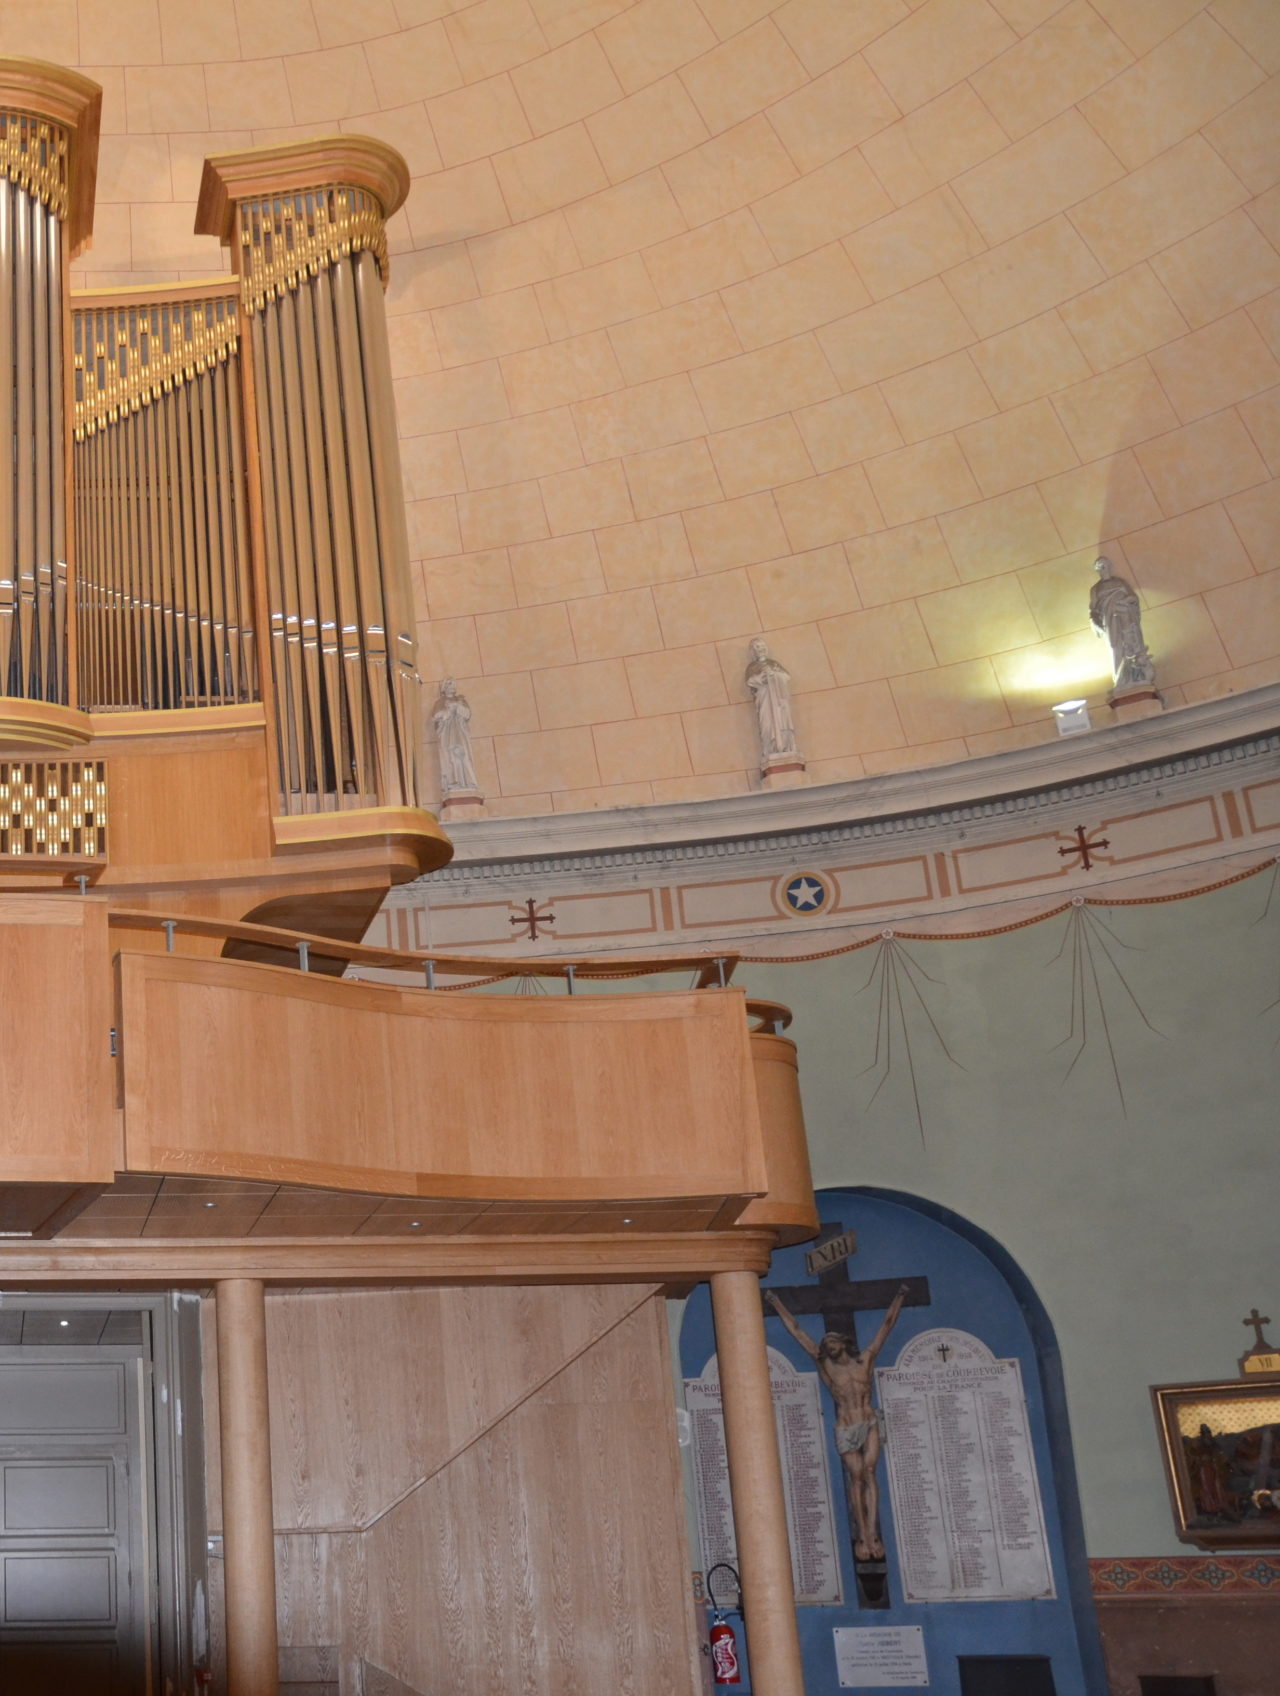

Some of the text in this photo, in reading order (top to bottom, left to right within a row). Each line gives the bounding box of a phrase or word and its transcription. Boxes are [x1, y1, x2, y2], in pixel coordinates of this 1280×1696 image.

[946, 1365, 1007, 1378] COURBEVOIE
[692, 1383, 721, 1393] PAROI
[949, 1382, 983, 1390] FRANCE
